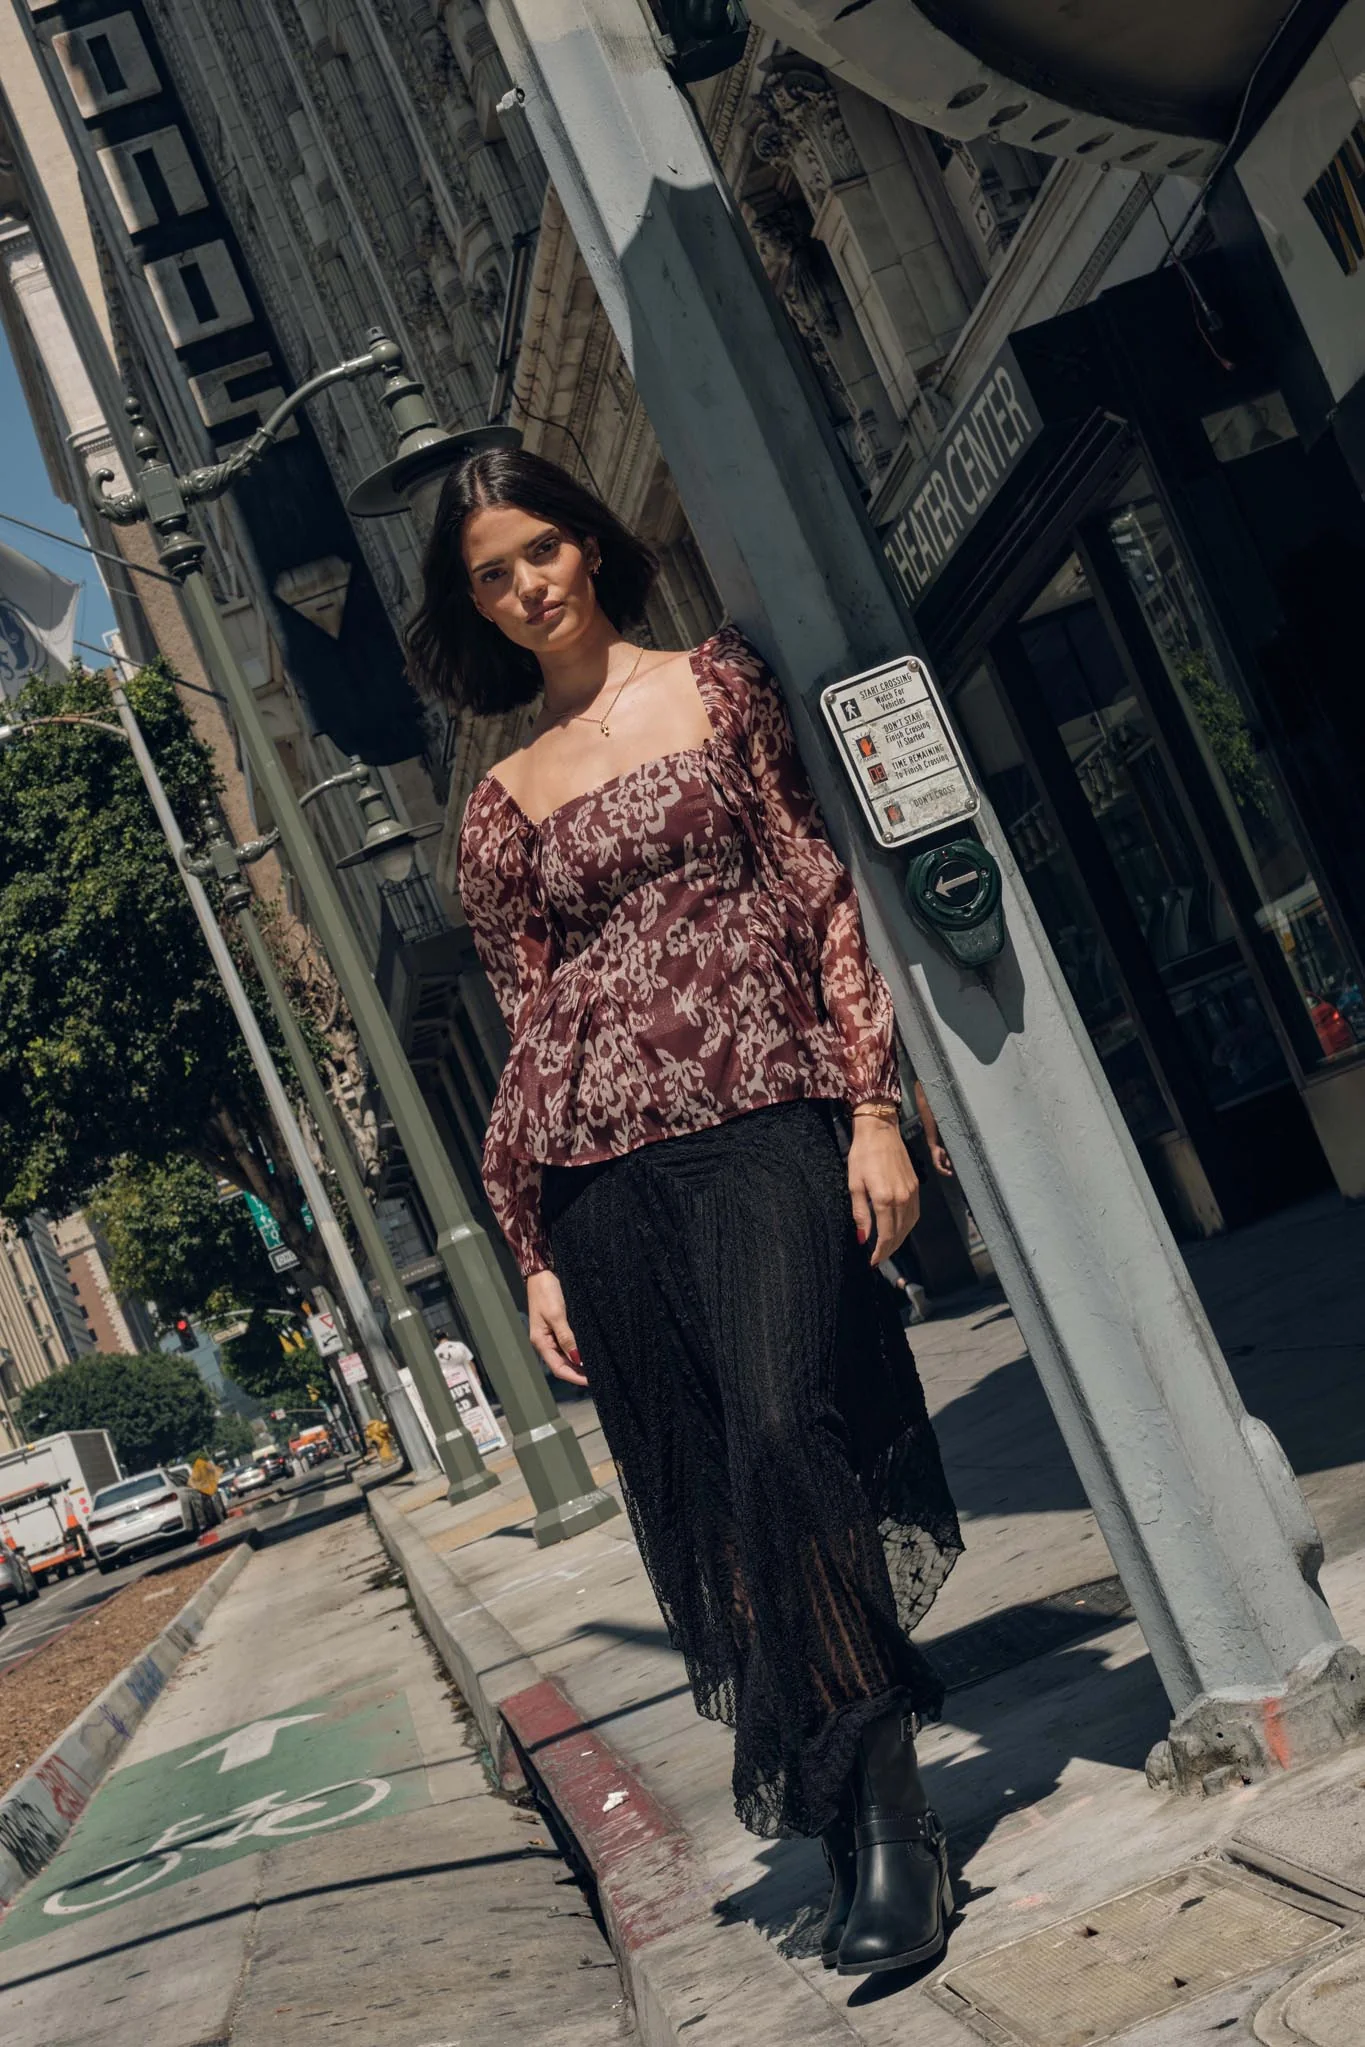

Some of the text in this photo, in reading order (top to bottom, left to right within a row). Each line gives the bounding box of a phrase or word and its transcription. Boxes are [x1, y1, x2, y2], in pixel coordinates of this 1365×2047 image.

[945, 365, 1032, 516] CENTER
[859, 672, 912, 699] START CROSSING
[875, 687, 905, 705] Watch For
[880, 698, 906, 711] Vehicles
[883, 711, 924, 733] DON'T START
[885, 721, 931, 744] Finish Crossing
[903, 732, 925, 746] Started
[892, 758, 907, 770] TIME
[909, 743, 945, 764] REMAINING
[895, 752, 950, 780] To Finish Crossing
[913, 792, 934, 808] DON'T
[934, 784, 956, 799] CROSS
